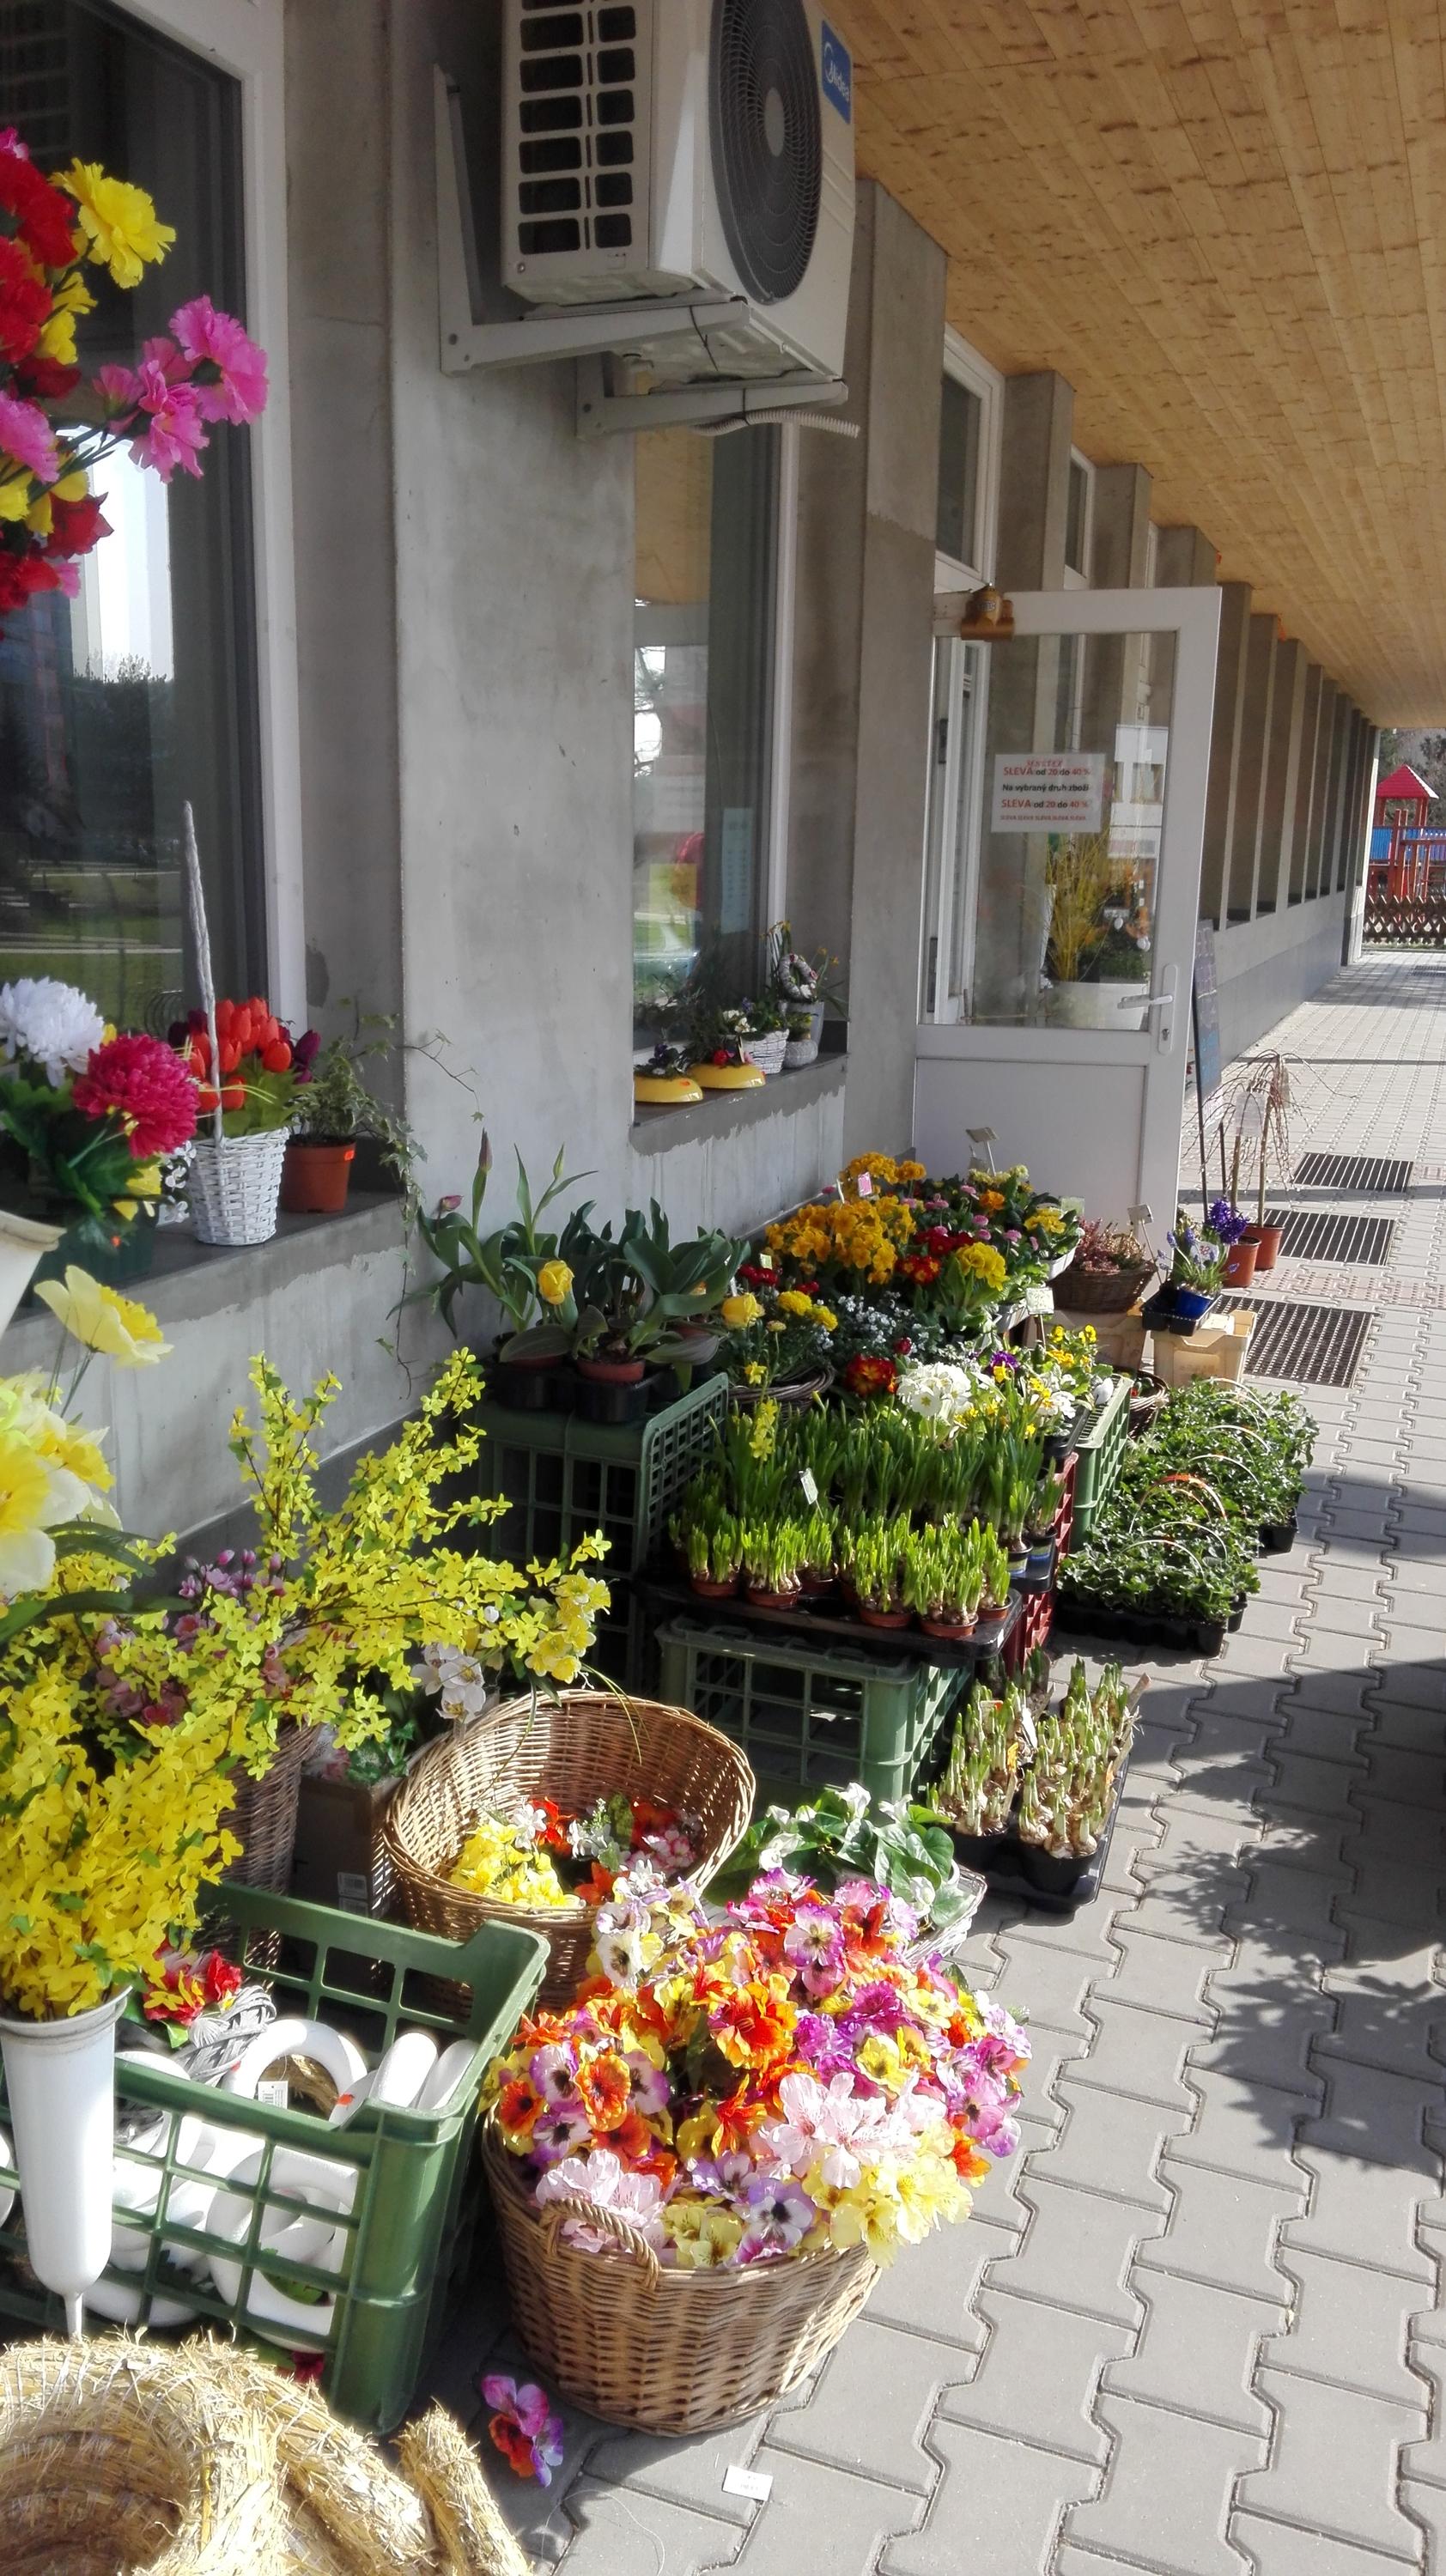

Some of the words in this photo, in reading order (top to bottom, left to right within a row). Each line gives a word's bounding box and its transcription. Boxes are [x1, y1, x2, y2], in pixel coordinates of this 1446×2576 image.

[1003, 767, 1032, 776] SLEVA
[1015, 783, 1046, 793] vybraný
[1068, 783, 1089, 792] zboží
[1001, 799, 1031, 808] SLEVA
[1033, 800, 1044, 809] od
[1045, 800, 1055, 809] 20
[1057, 800, 1068, 809] do
